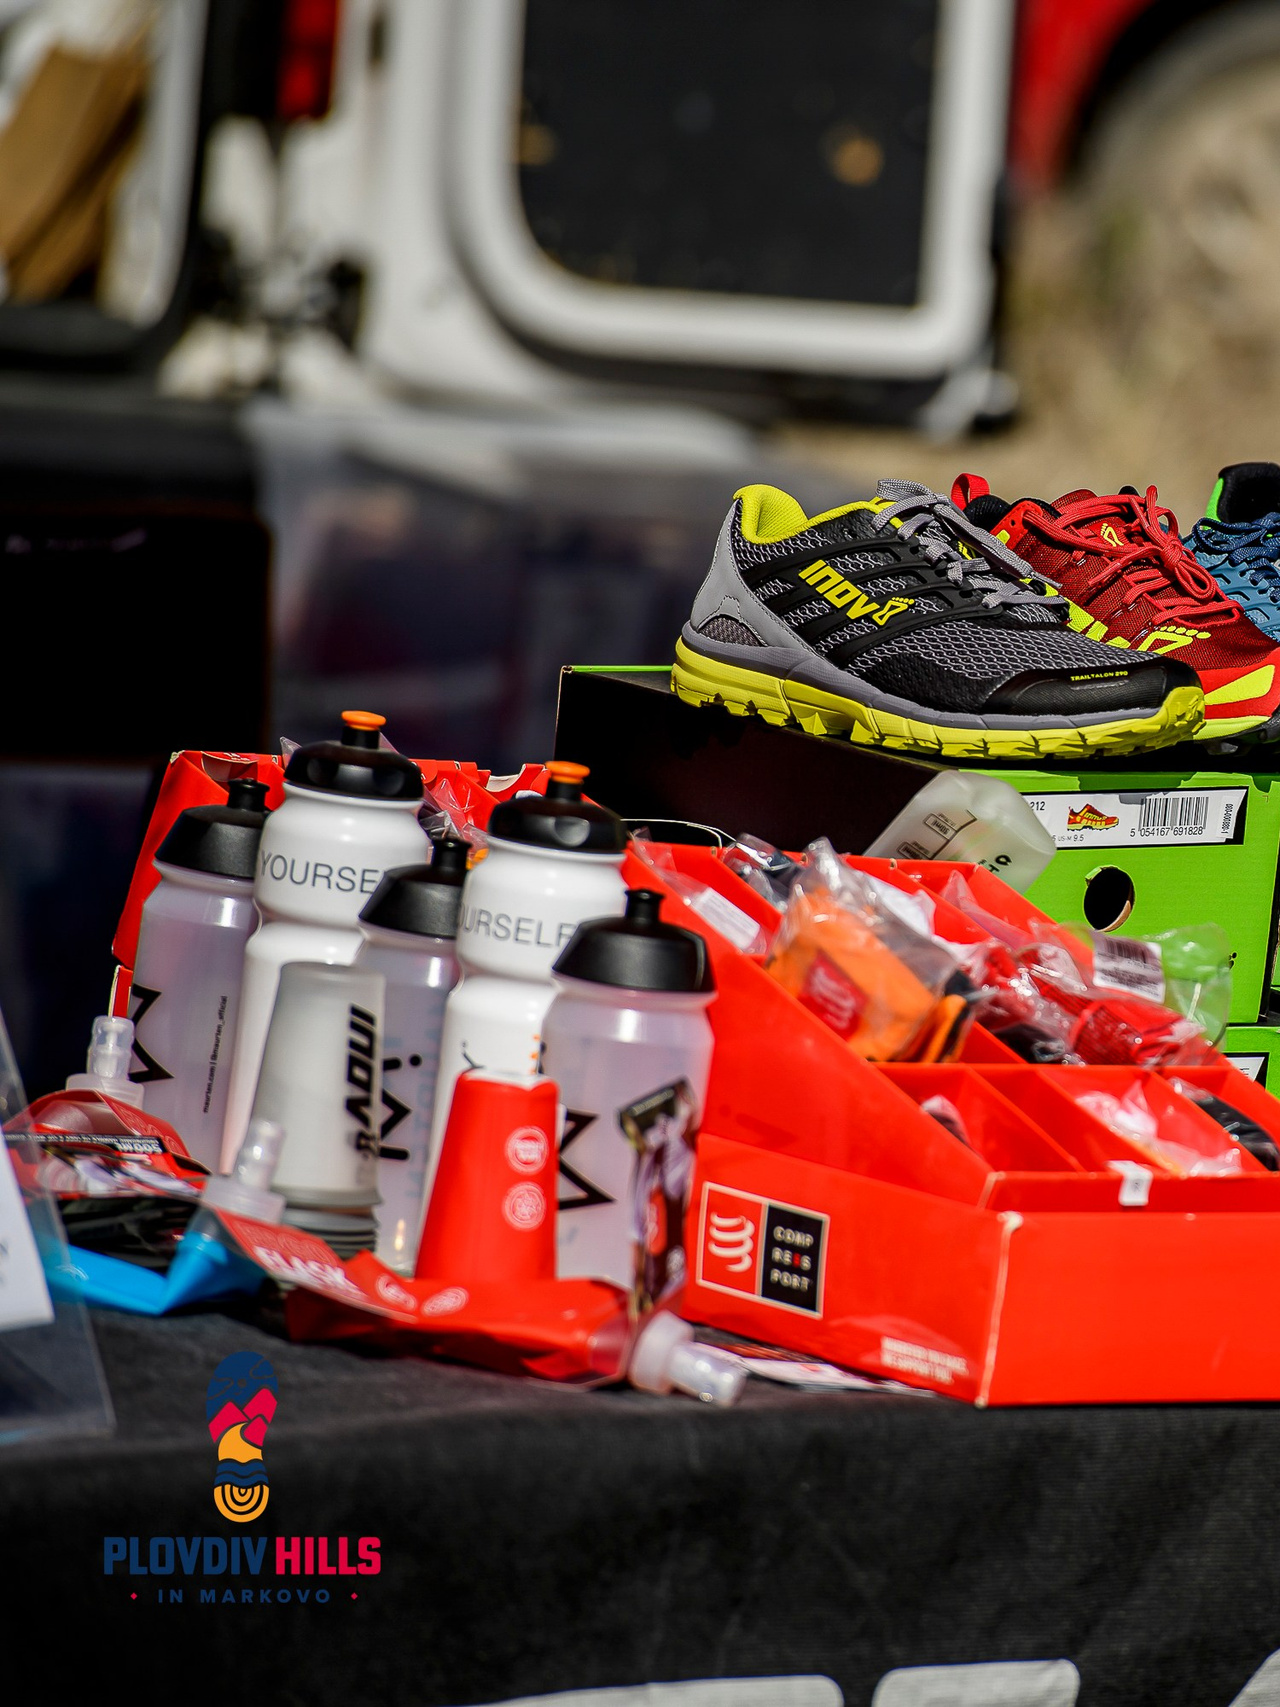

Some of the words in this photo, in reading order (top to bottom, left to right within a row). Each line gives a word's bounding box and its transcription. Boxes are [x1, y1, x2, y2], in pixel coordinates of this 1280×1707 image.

[1140, 827, 1170, 837] 054167
[1173, 826, 1203, 836] 691828
[260, 851, 387, 894] YOURSE
[773, 1225, 814, 1248] COMP
[770, 1268, 812, 1292] PORT
